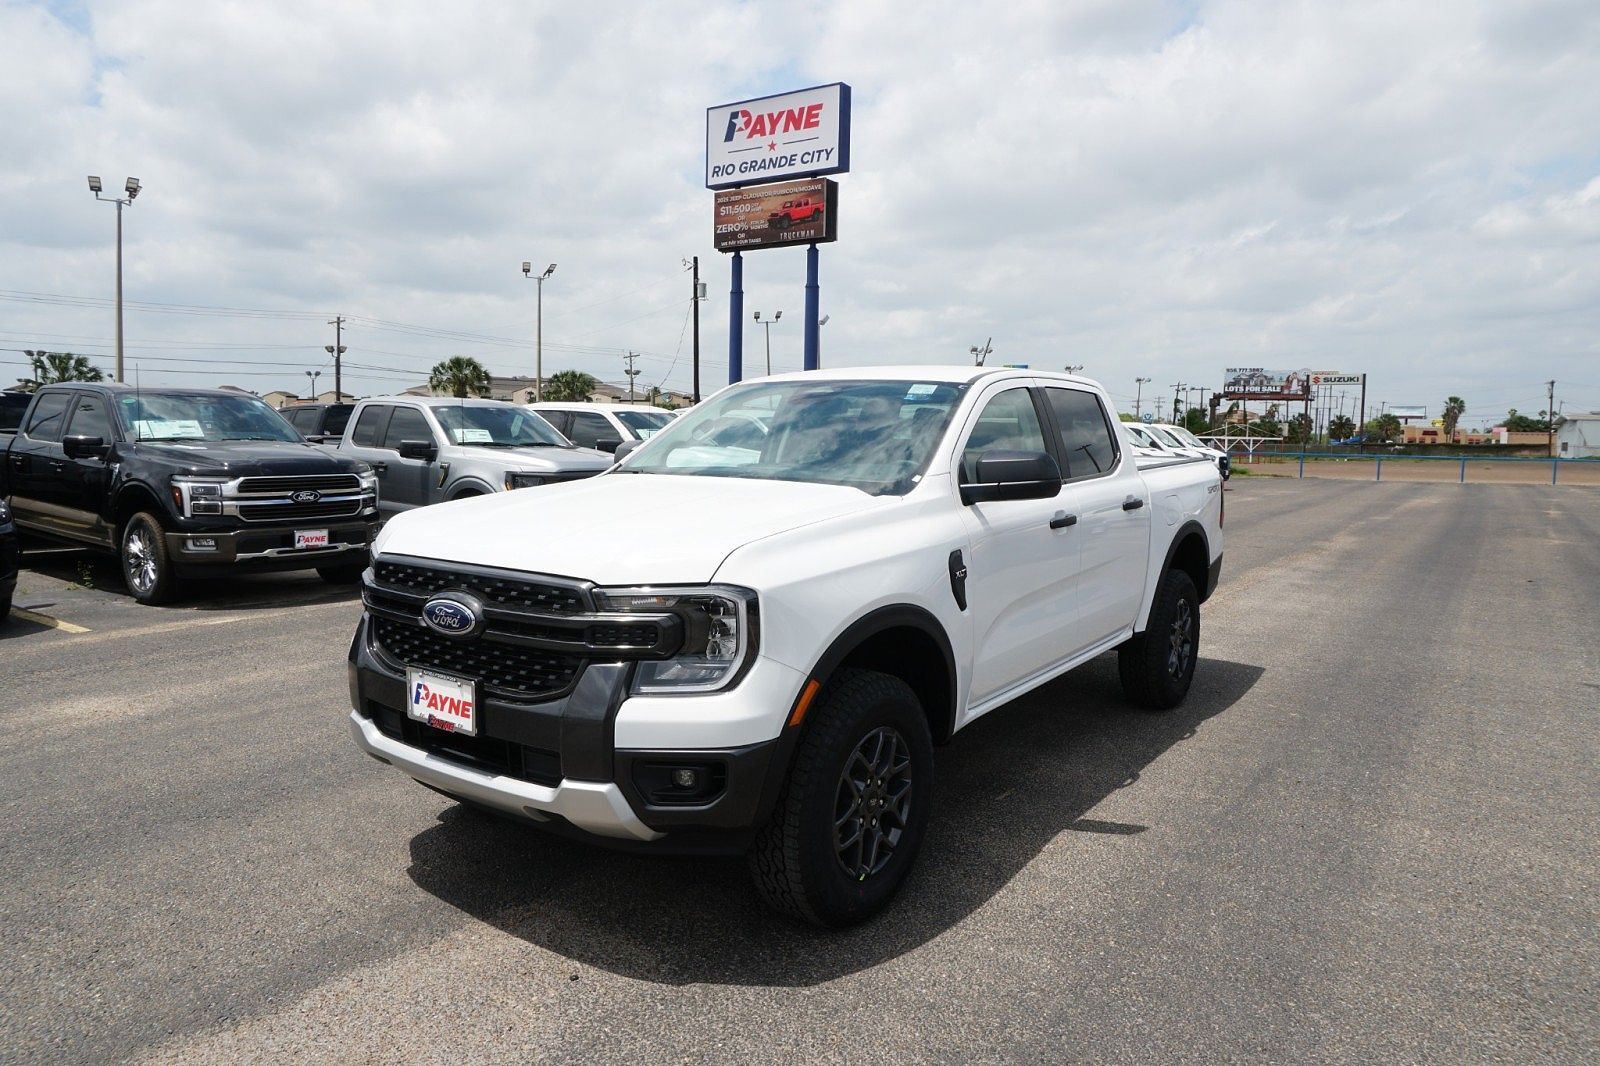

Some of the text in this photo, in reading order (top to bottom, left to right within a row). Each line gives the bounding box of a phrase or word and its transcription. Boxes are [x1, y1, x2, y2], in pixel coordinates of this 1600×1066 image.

[723, 103, 824, 142] PAYNE
[711, 147, 835, 178] RIO GRANDE CITY
[742, 190, 772, 200] GLADIATOR
[720, 203, 751, 217] $11,500
[716, 221, 749, 234] ZERO%
[780, 229, 815, 240] TRUCKMAN
[297, 535, 327, 544] PAYNE
[432, 606, 461, 628] Ford
[413, 682, 473, 719] PAYNE
